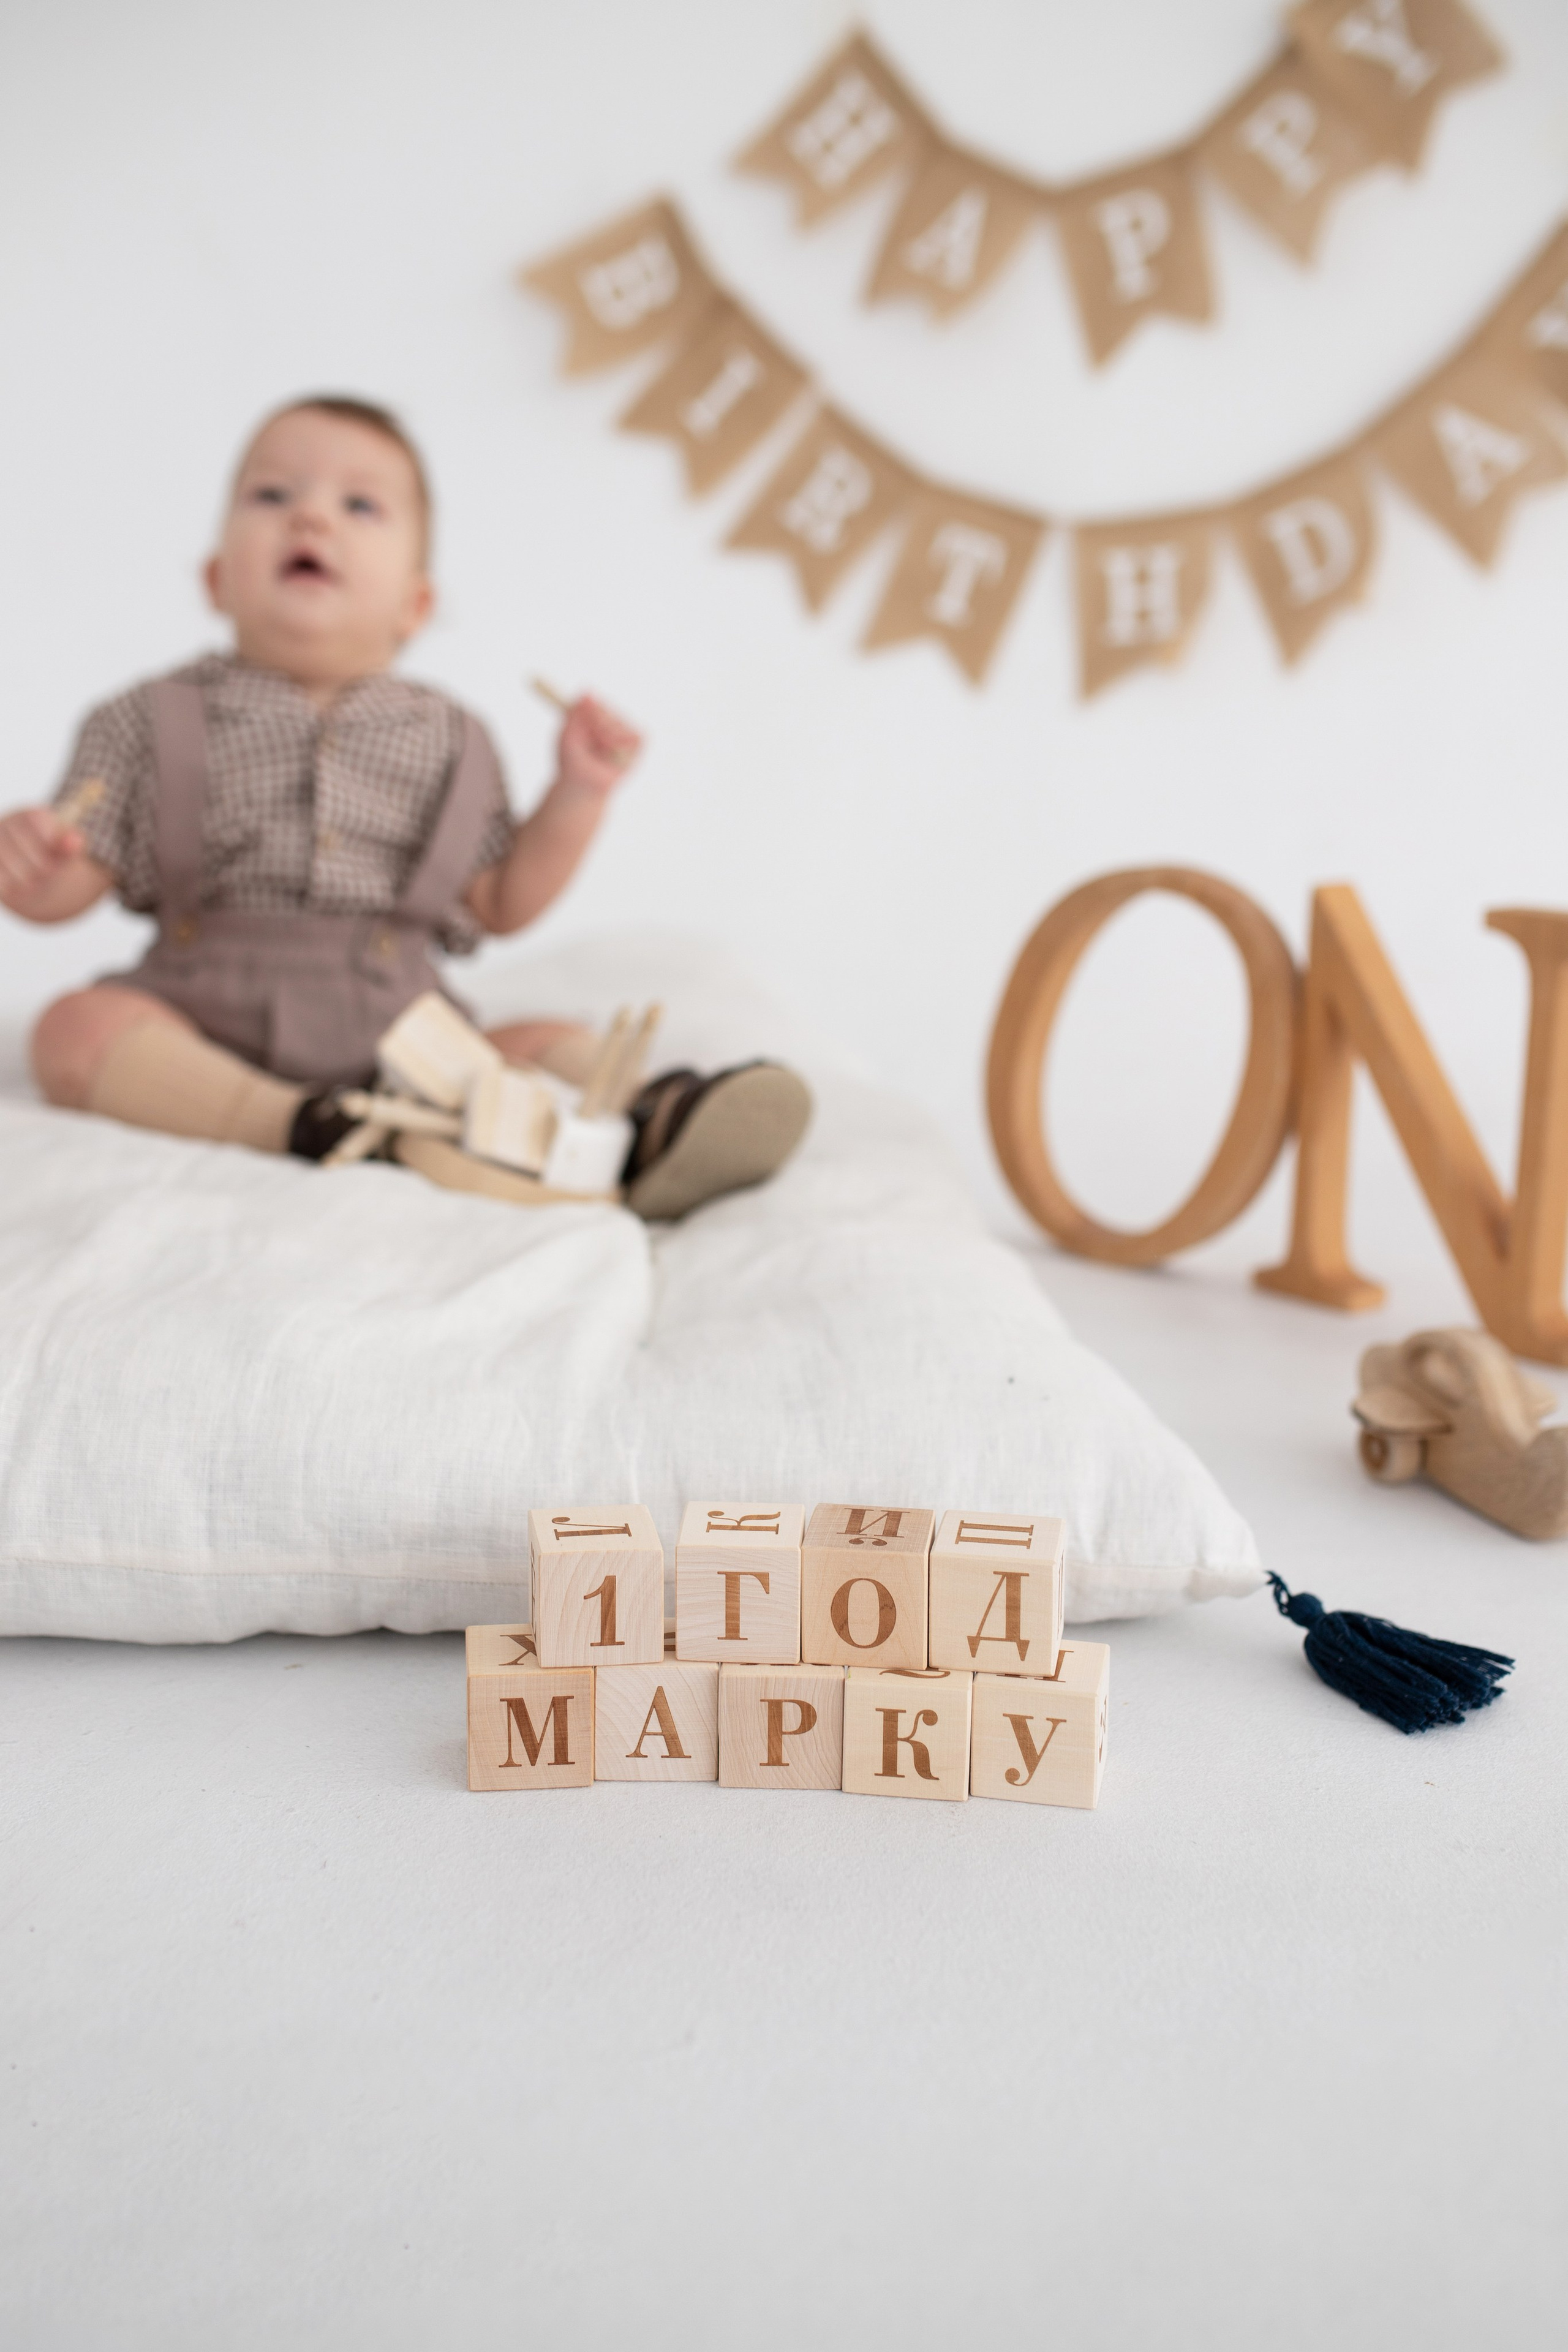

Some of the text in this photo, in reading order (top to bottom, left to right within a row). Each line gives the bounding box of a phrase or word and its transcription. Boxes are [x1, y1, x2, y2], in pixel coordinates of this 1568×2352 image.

[784, 0, 1436, 301] HAPPY
[584, 1575, 625, 1646] 1
[717, 1571, 1030, 1661] ГОД
[499, 1686, 1066, 1787] МАРКУ
